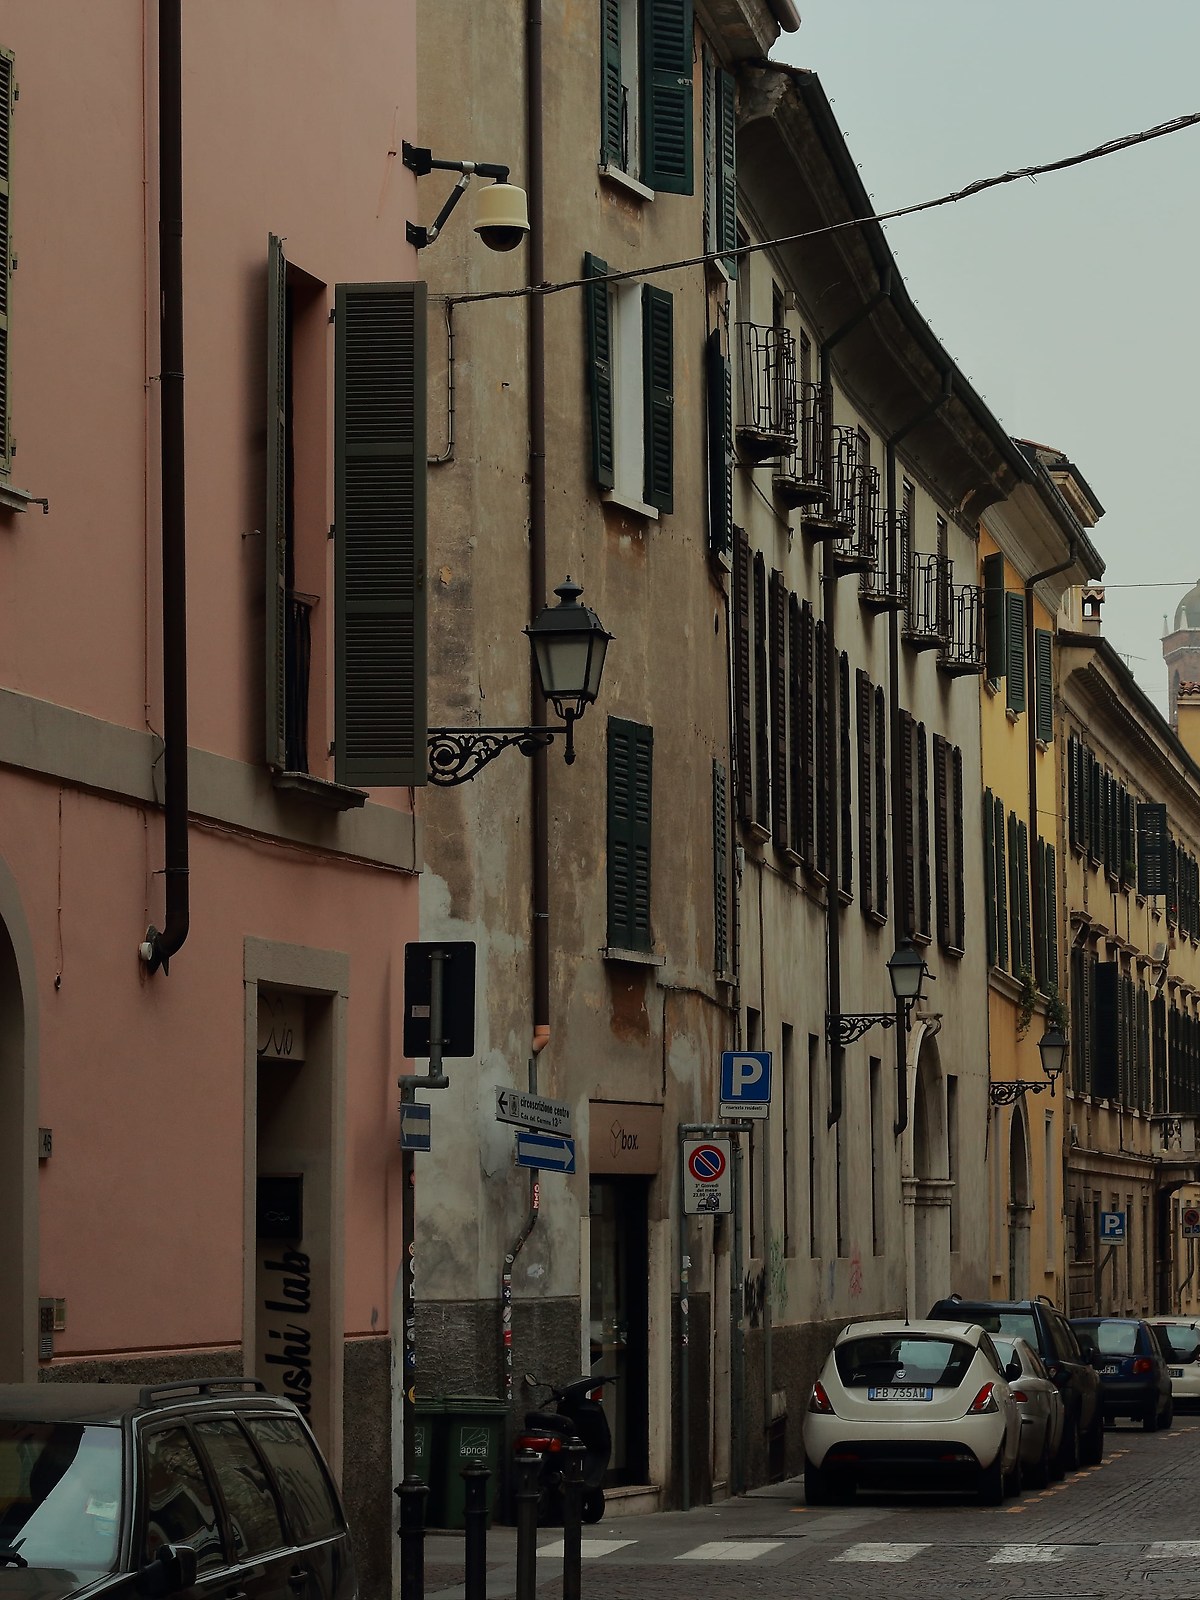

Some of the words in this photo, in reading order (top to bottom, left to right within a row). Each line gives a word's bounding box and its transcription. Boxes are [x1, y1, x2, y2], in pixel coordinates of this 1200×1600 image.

[732, 1057, 763, 1097] P
[520, 1096, 553, 1114] circoscrizione
[554, 1107, 569, 1119] centro
[1104, 1215, 1120, 1234] P
[264, 1250, 310, 1313] lab
[265, 1324, 312, 1428] ushi
[875, 1386, 889, 1398] FB
